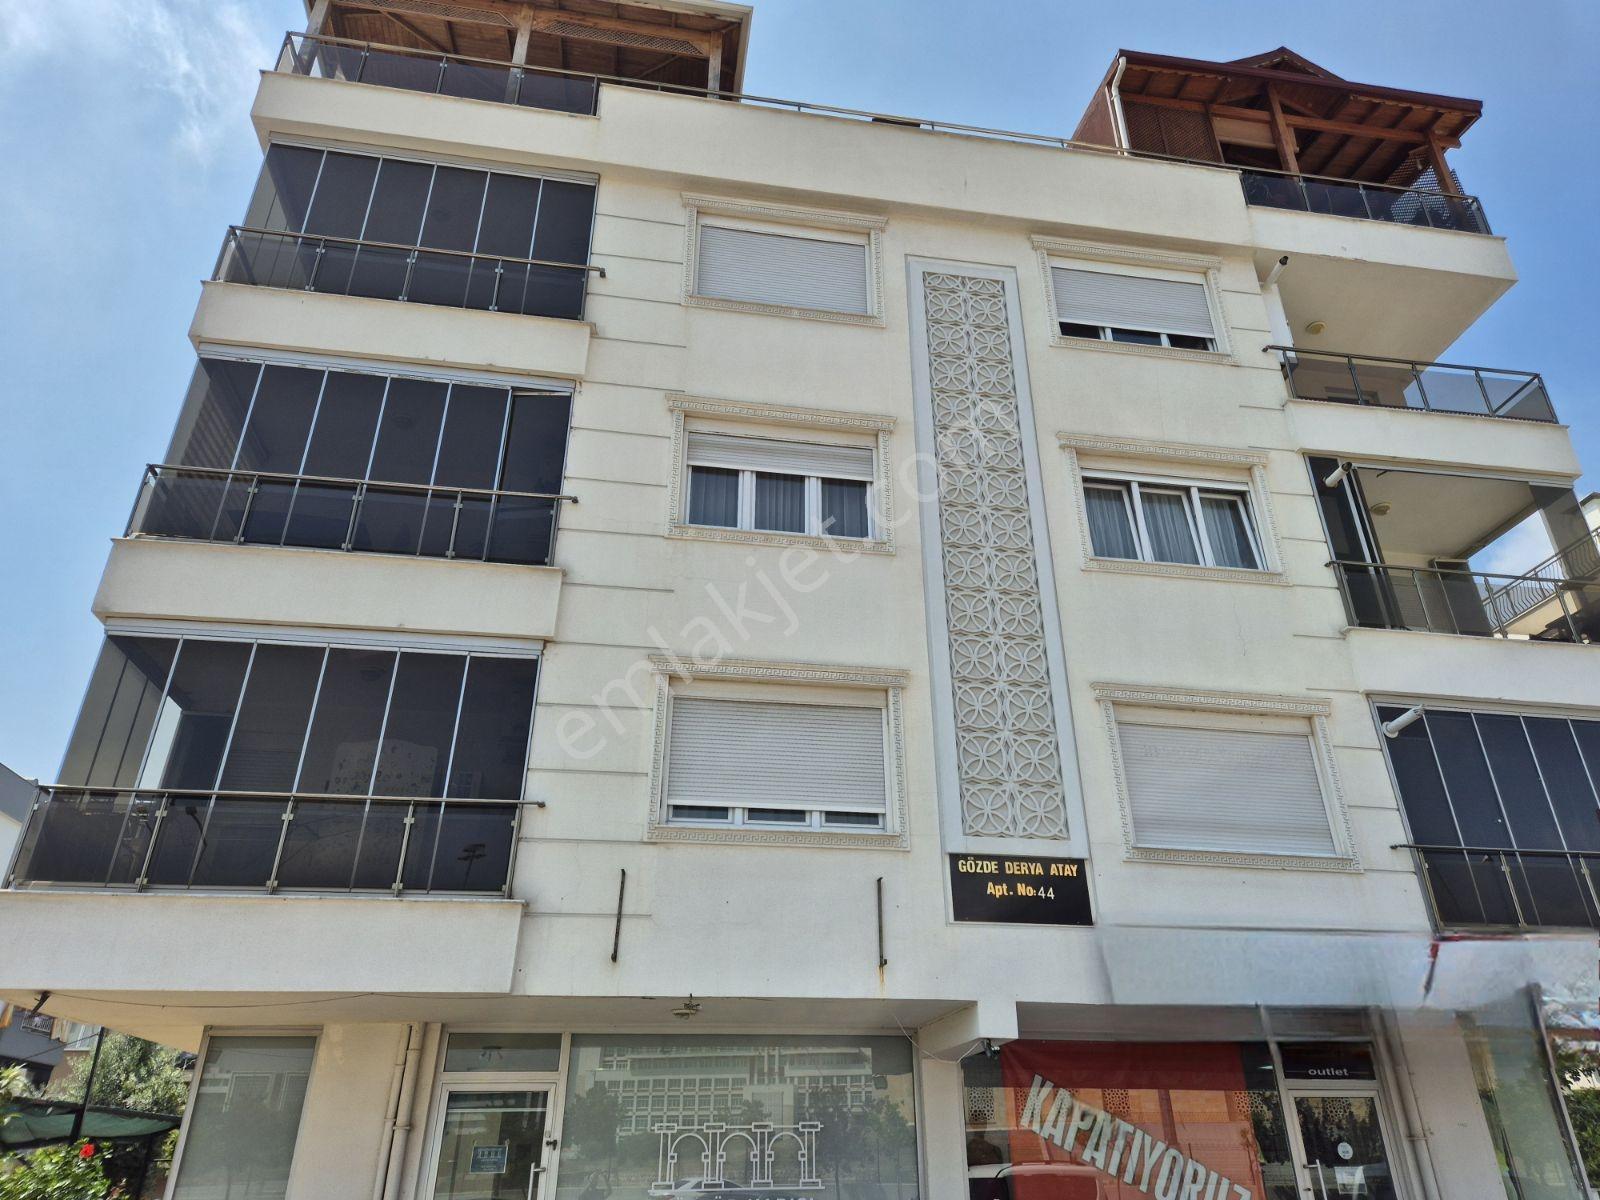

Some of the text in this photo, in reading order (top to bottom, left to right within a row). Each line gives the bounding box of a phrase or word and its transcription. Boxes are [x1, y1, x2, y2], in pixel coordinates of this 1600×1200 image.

[958, 857, 1078, 877] GÖZDE DERYA ATAY
[986, 882, 1014, 898] Apt.
[1308, 1068, 1349, 1076] outlet
